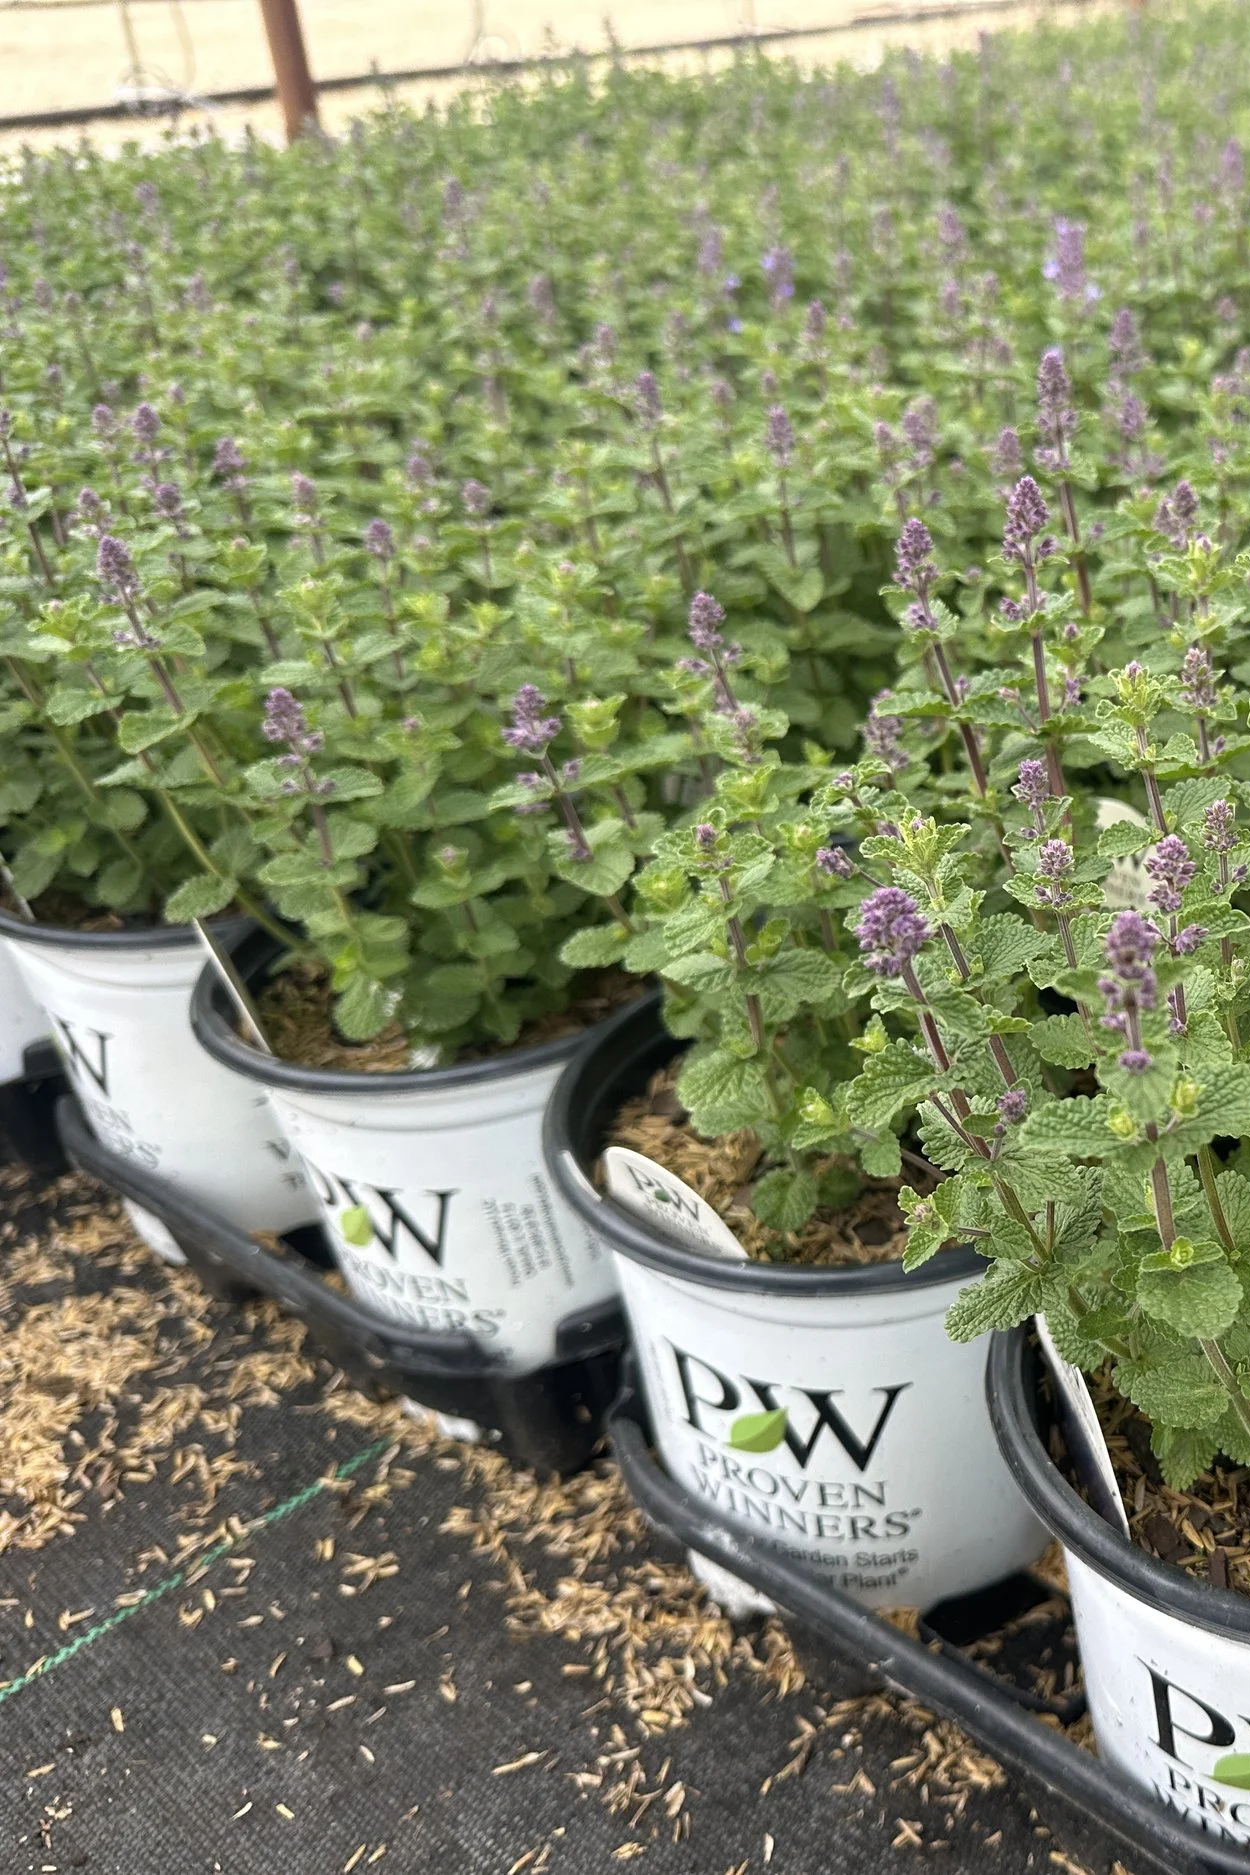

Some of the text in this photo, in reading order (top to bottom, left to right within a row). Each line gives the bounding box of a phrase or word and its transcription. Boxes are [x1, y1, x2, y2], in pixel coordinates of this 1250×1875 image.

[621, 1160, 701, 1222] PW
[663, 1334, 915, 1473] PW
[697, 1440, 889, 1508] PROVEN
[855, 1547, 920, 1568] Starts
